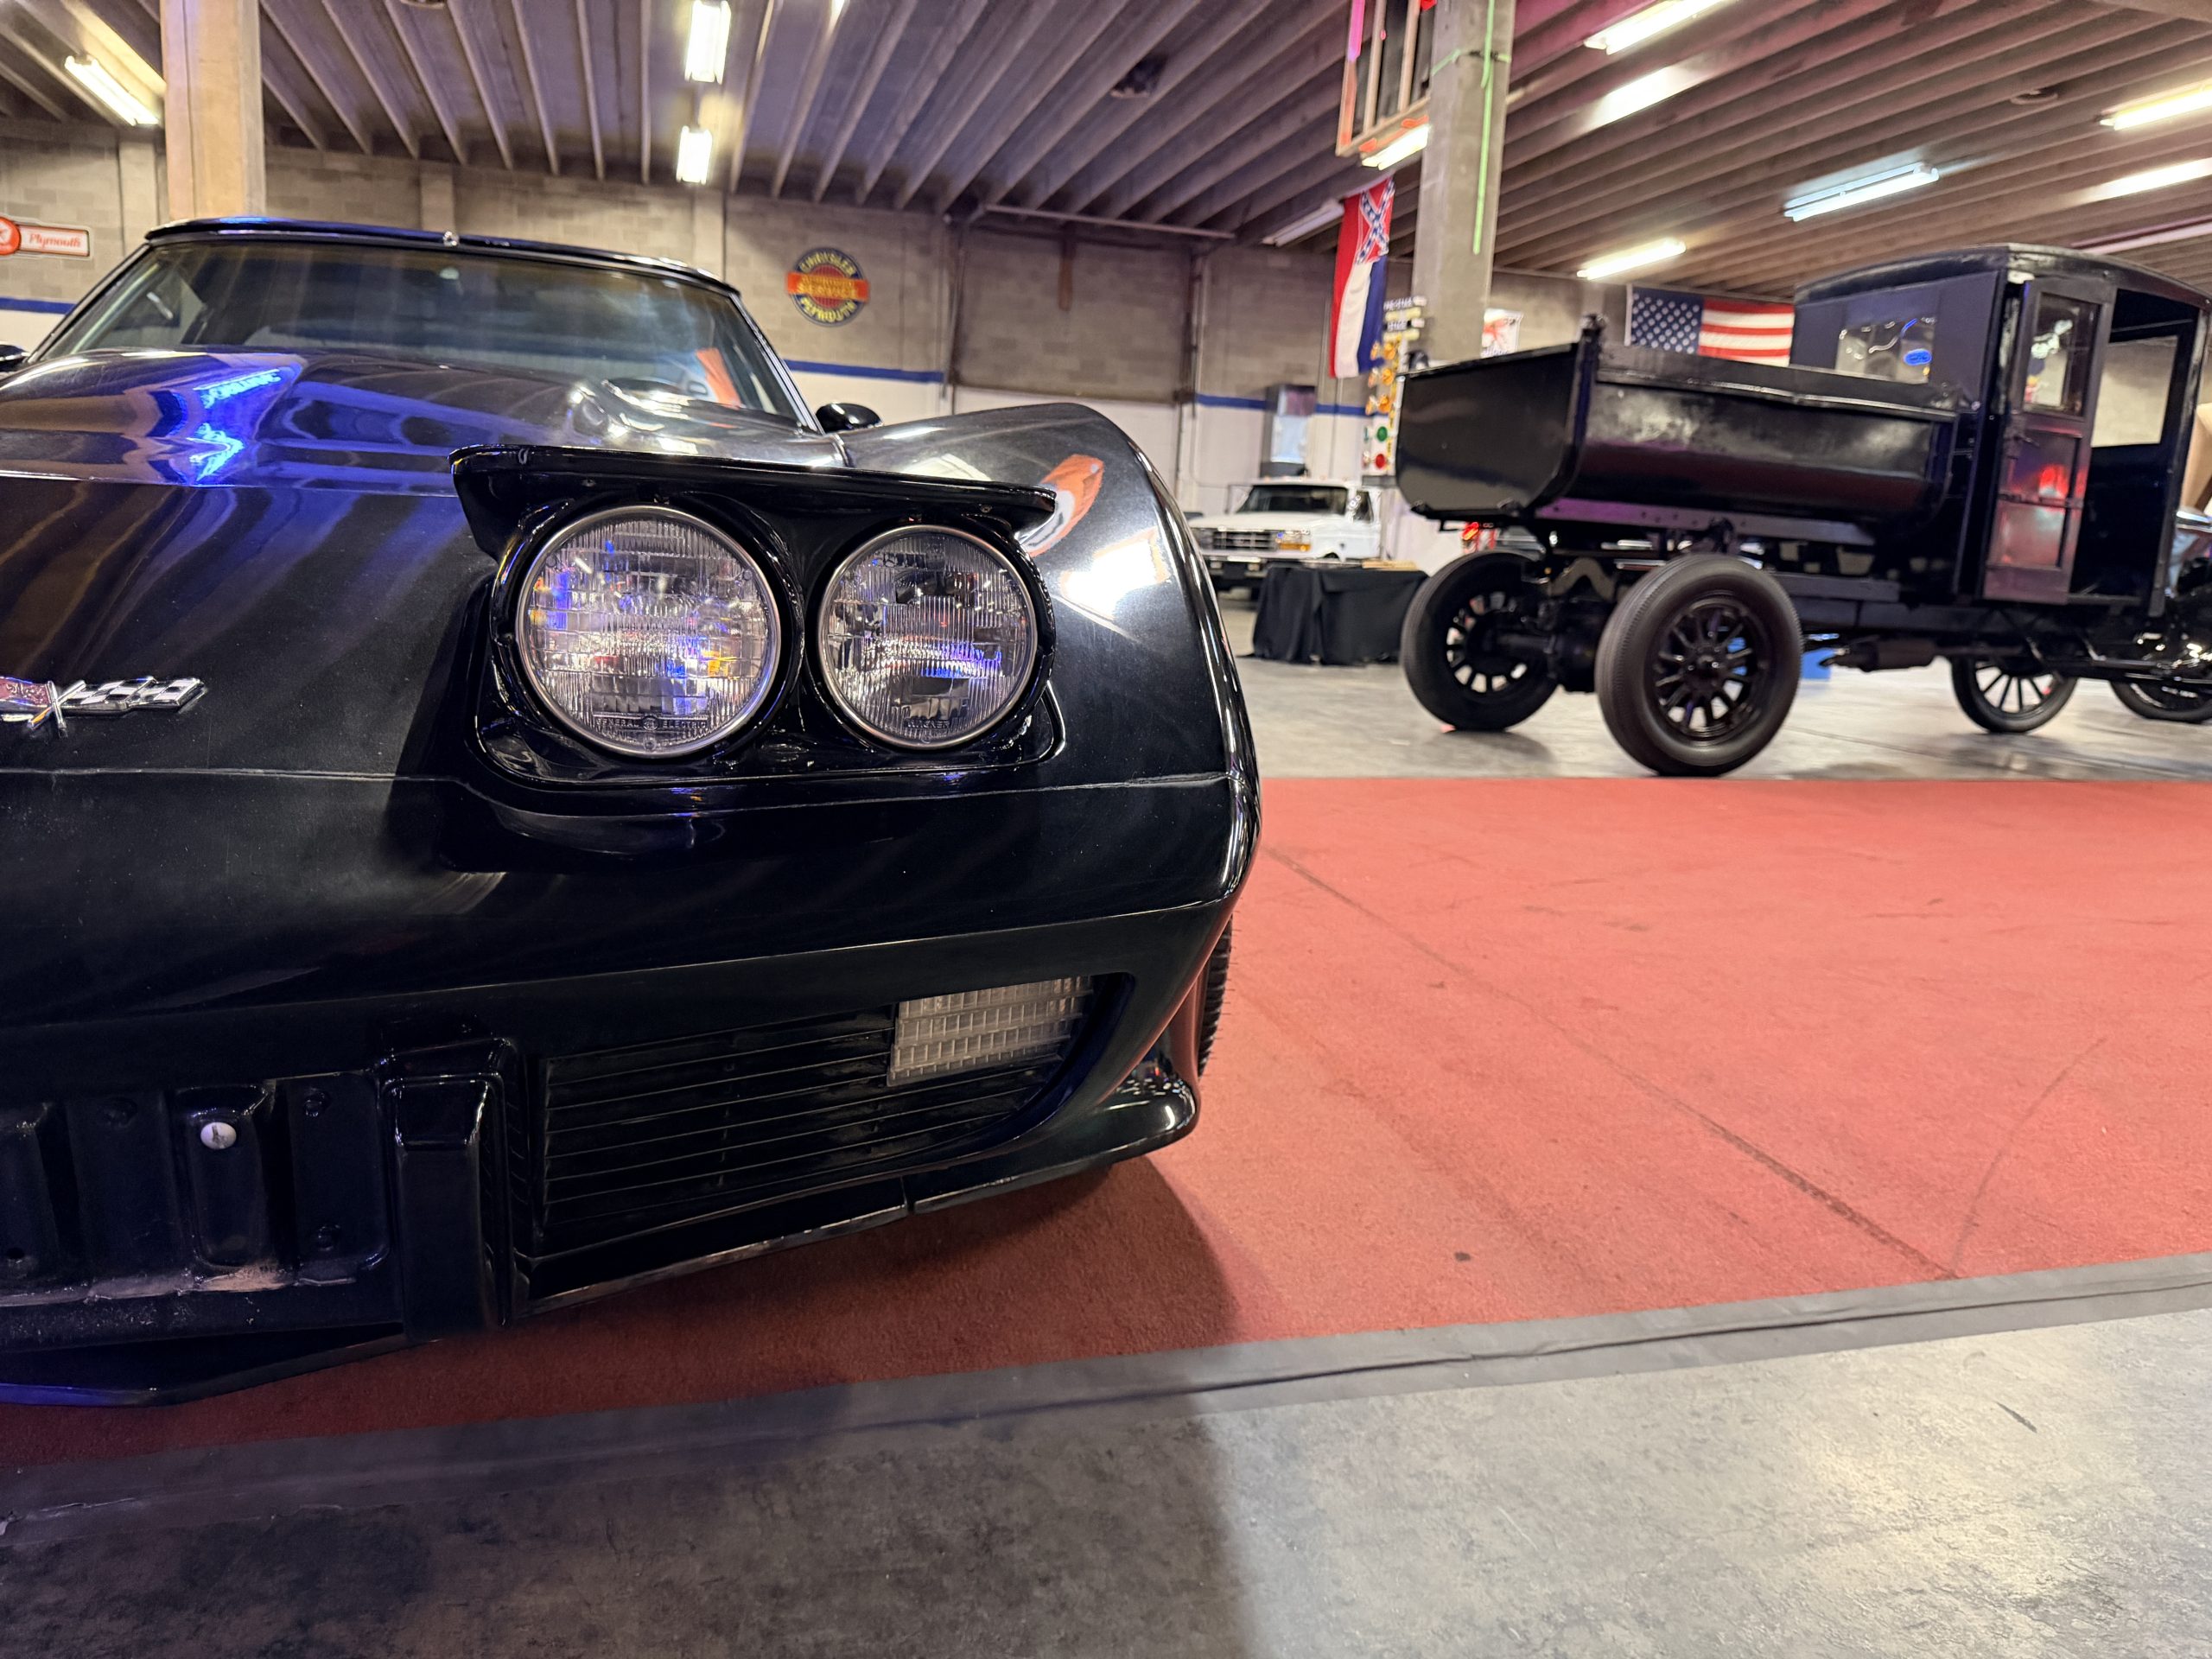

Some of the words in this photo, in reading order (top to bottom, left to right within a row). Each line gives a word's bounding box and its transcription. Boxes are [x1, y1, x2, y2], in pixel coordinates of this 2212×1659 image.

[29, 233, 81, 249] Plymouth
[798, 251, 857, 276] CHRYSLER
[799, 296, 858, 322] PLYMOUTH
[596, 717, 640, 728] GENERAL
[662, 719, 707, 728] ELECTRIC
